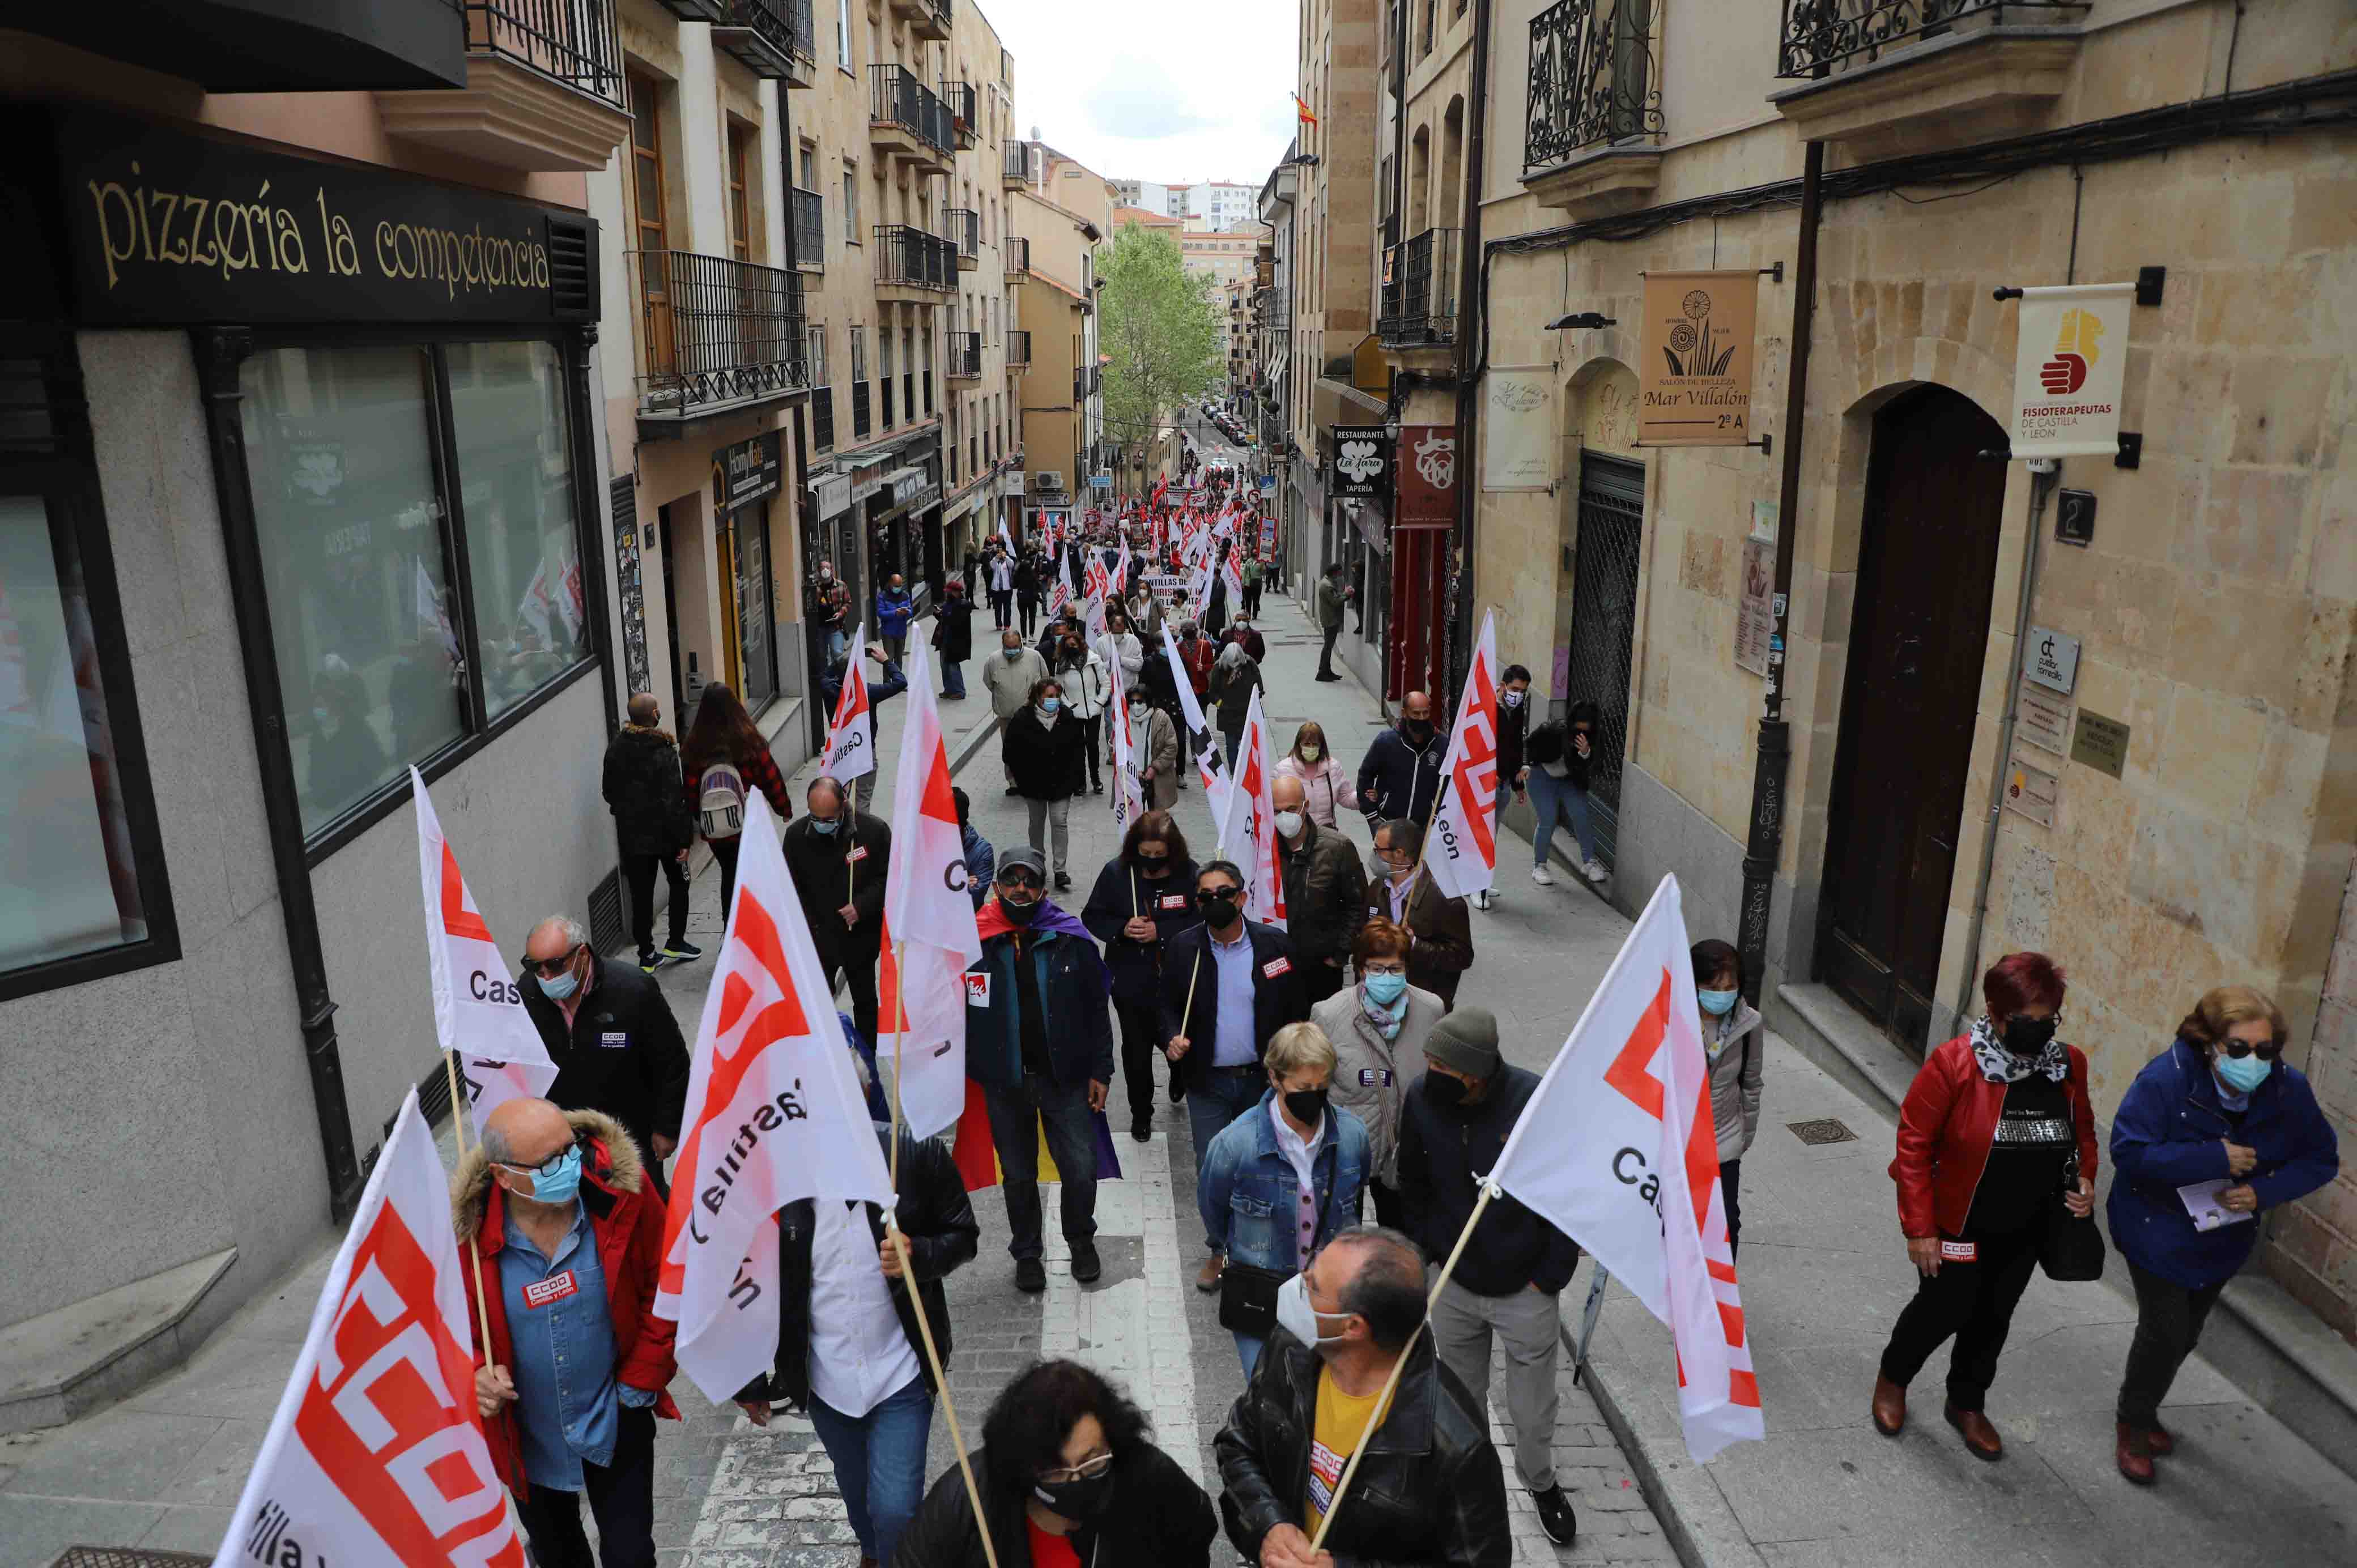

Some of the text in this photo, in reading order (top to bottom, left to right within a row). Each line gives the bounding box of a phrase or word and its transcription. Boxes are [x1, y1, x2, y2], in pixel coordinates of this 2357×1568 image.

[88, 161, 551, 301] pizzería la competencia
[1644, 386, 1748, 406] Mar Villalón
[2022, 404, 2112, 417] FISIOTERAPEUTAS
[1734, 414, 1743, 429] A
[2022, 417, 2078, 428] DE CASTILLA
[1337, 431, 1385, 439] RESTAURANTE
[2021, 429, 2027, 439] Y
[1339, 458, 1381, 468] La Jara
[1346, 483, 1373, 493] TAPERÍA
[530, 1277, 567, 1296] CCOO
